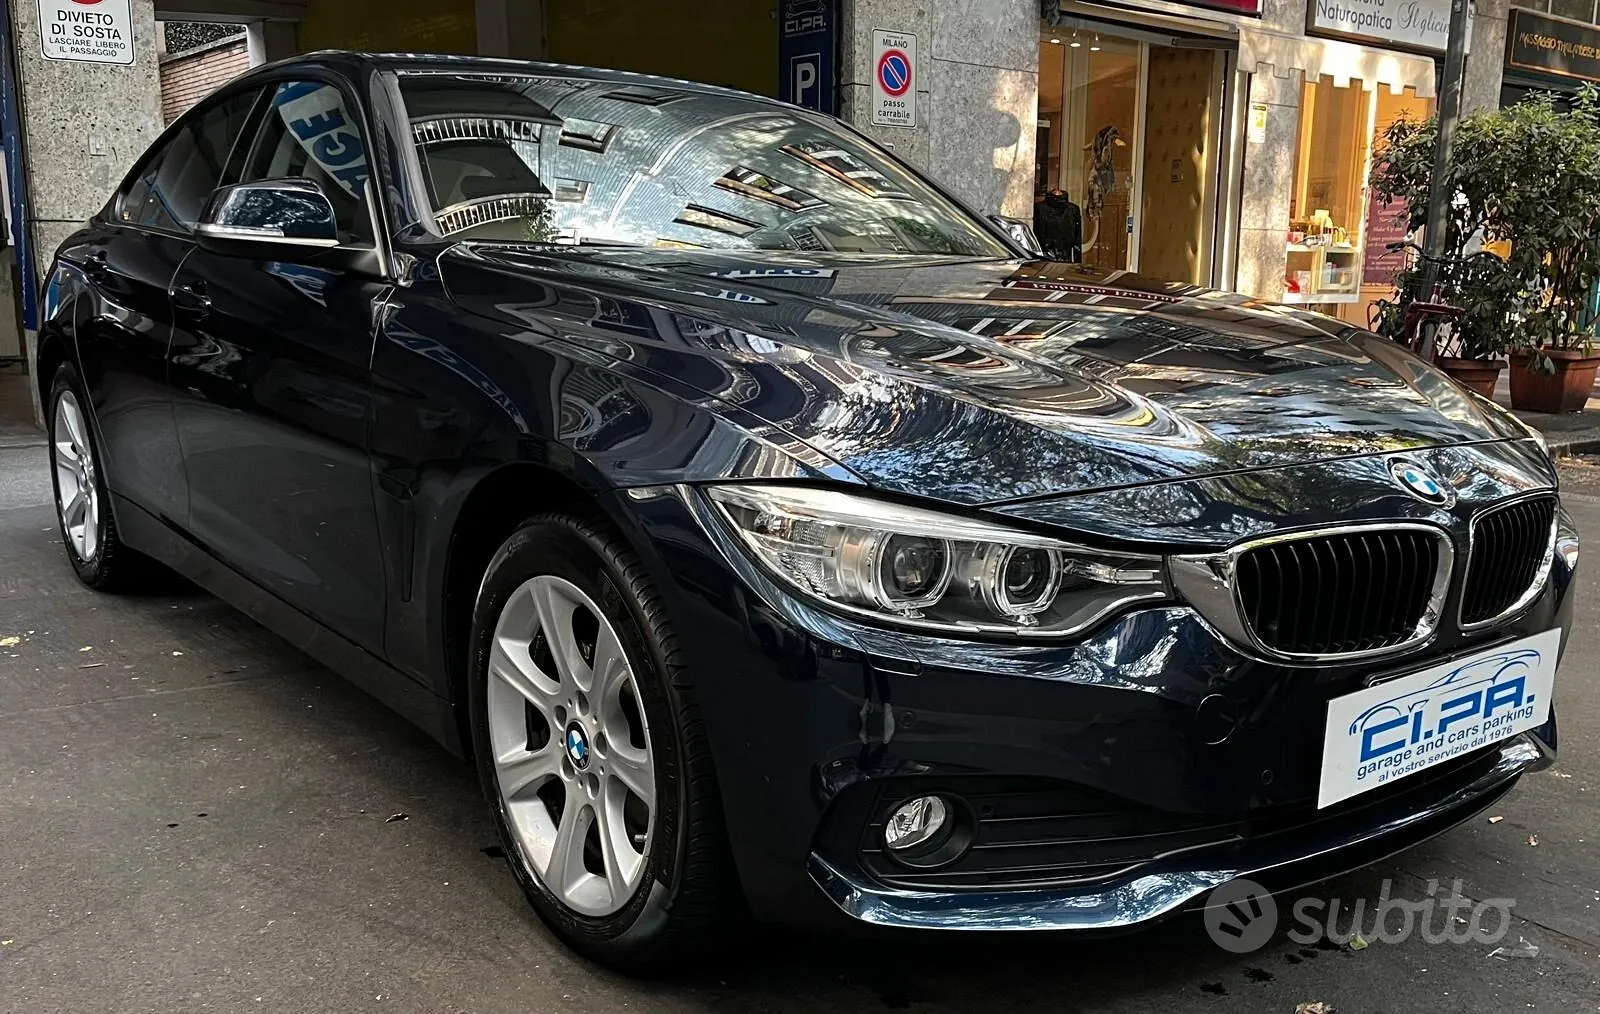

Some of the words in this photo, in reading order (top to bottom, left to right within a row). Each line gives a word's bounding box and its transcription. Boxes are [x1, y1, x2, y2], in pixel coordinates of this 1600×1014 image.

[57, 10, 113, 25] DIVIETO
[1316, 0, 1392, 30] Naturopatica
[1420, 10, 1449, 37] glicin
[51, 24, 66, 35] DI
[73, 26, 122, 40] SOSTA
[785, 15, 827, 33] CI.PA.
[49, 37, 91, 47] LASCIARE
[95, 41, 126, 50] LIBERO
[70, 47, 118, 57] PASSAGGIO
[882, 38, 908, 49] MILANO
[796, 62, 816, 105] P
[883, 100, 905, 109] passo
[877, 110, 911, 120] carrabile
[1360, 676, 1535, 763] CI.PA.
[1357, 749, 1412, 780] garage
[1416, 734, 1444, 756] and
[1448, 724, 1479, 744] cars
[1483, 705, 1534, 735] parking
[1378, 770, 1389, 782] al
[1392, 759, 1425, 777] vostro
[1428, 743, 1468, 763] servizio
[1471, 735, 1487, 748] dal
[1490, 725, 1513, 741] 1976
